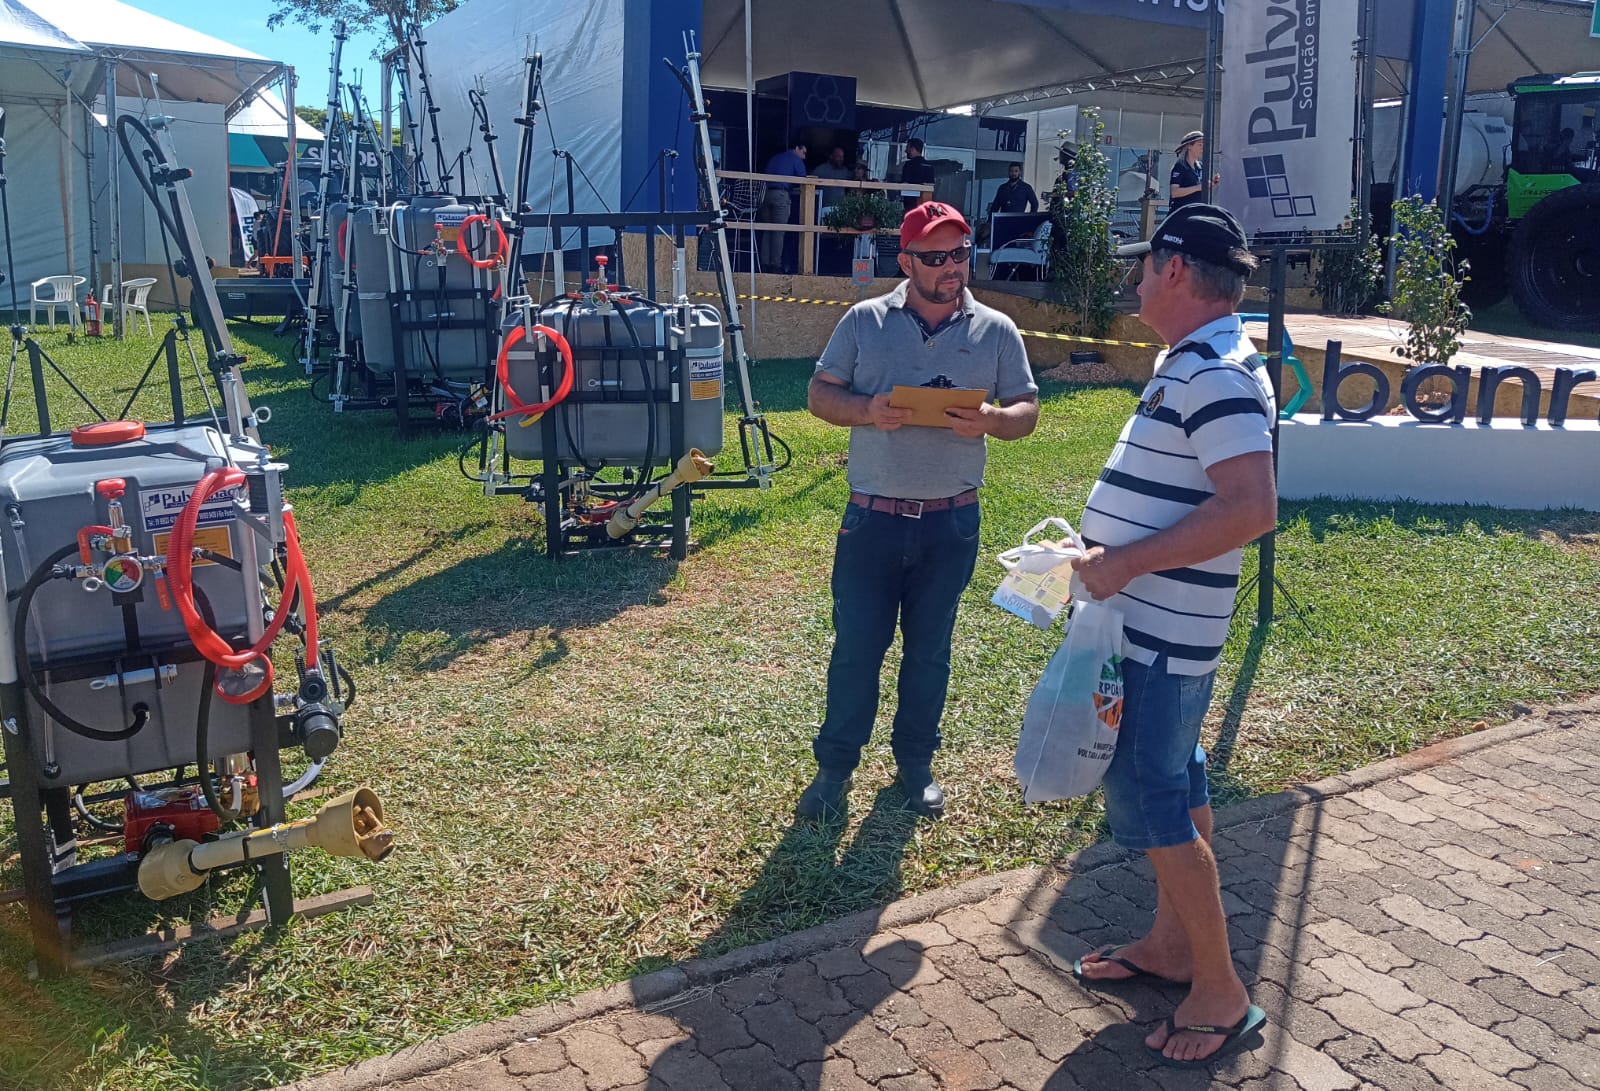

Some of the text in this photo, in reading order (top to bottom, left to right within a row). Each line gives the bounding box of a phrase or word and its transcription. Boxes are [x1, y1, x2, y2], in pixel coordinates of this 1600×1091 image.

[1245, 0, 1304, 145] Pulv
[1300, 0, 1317, 110] Solução em
[1321, 339, 1600, 426] banr
